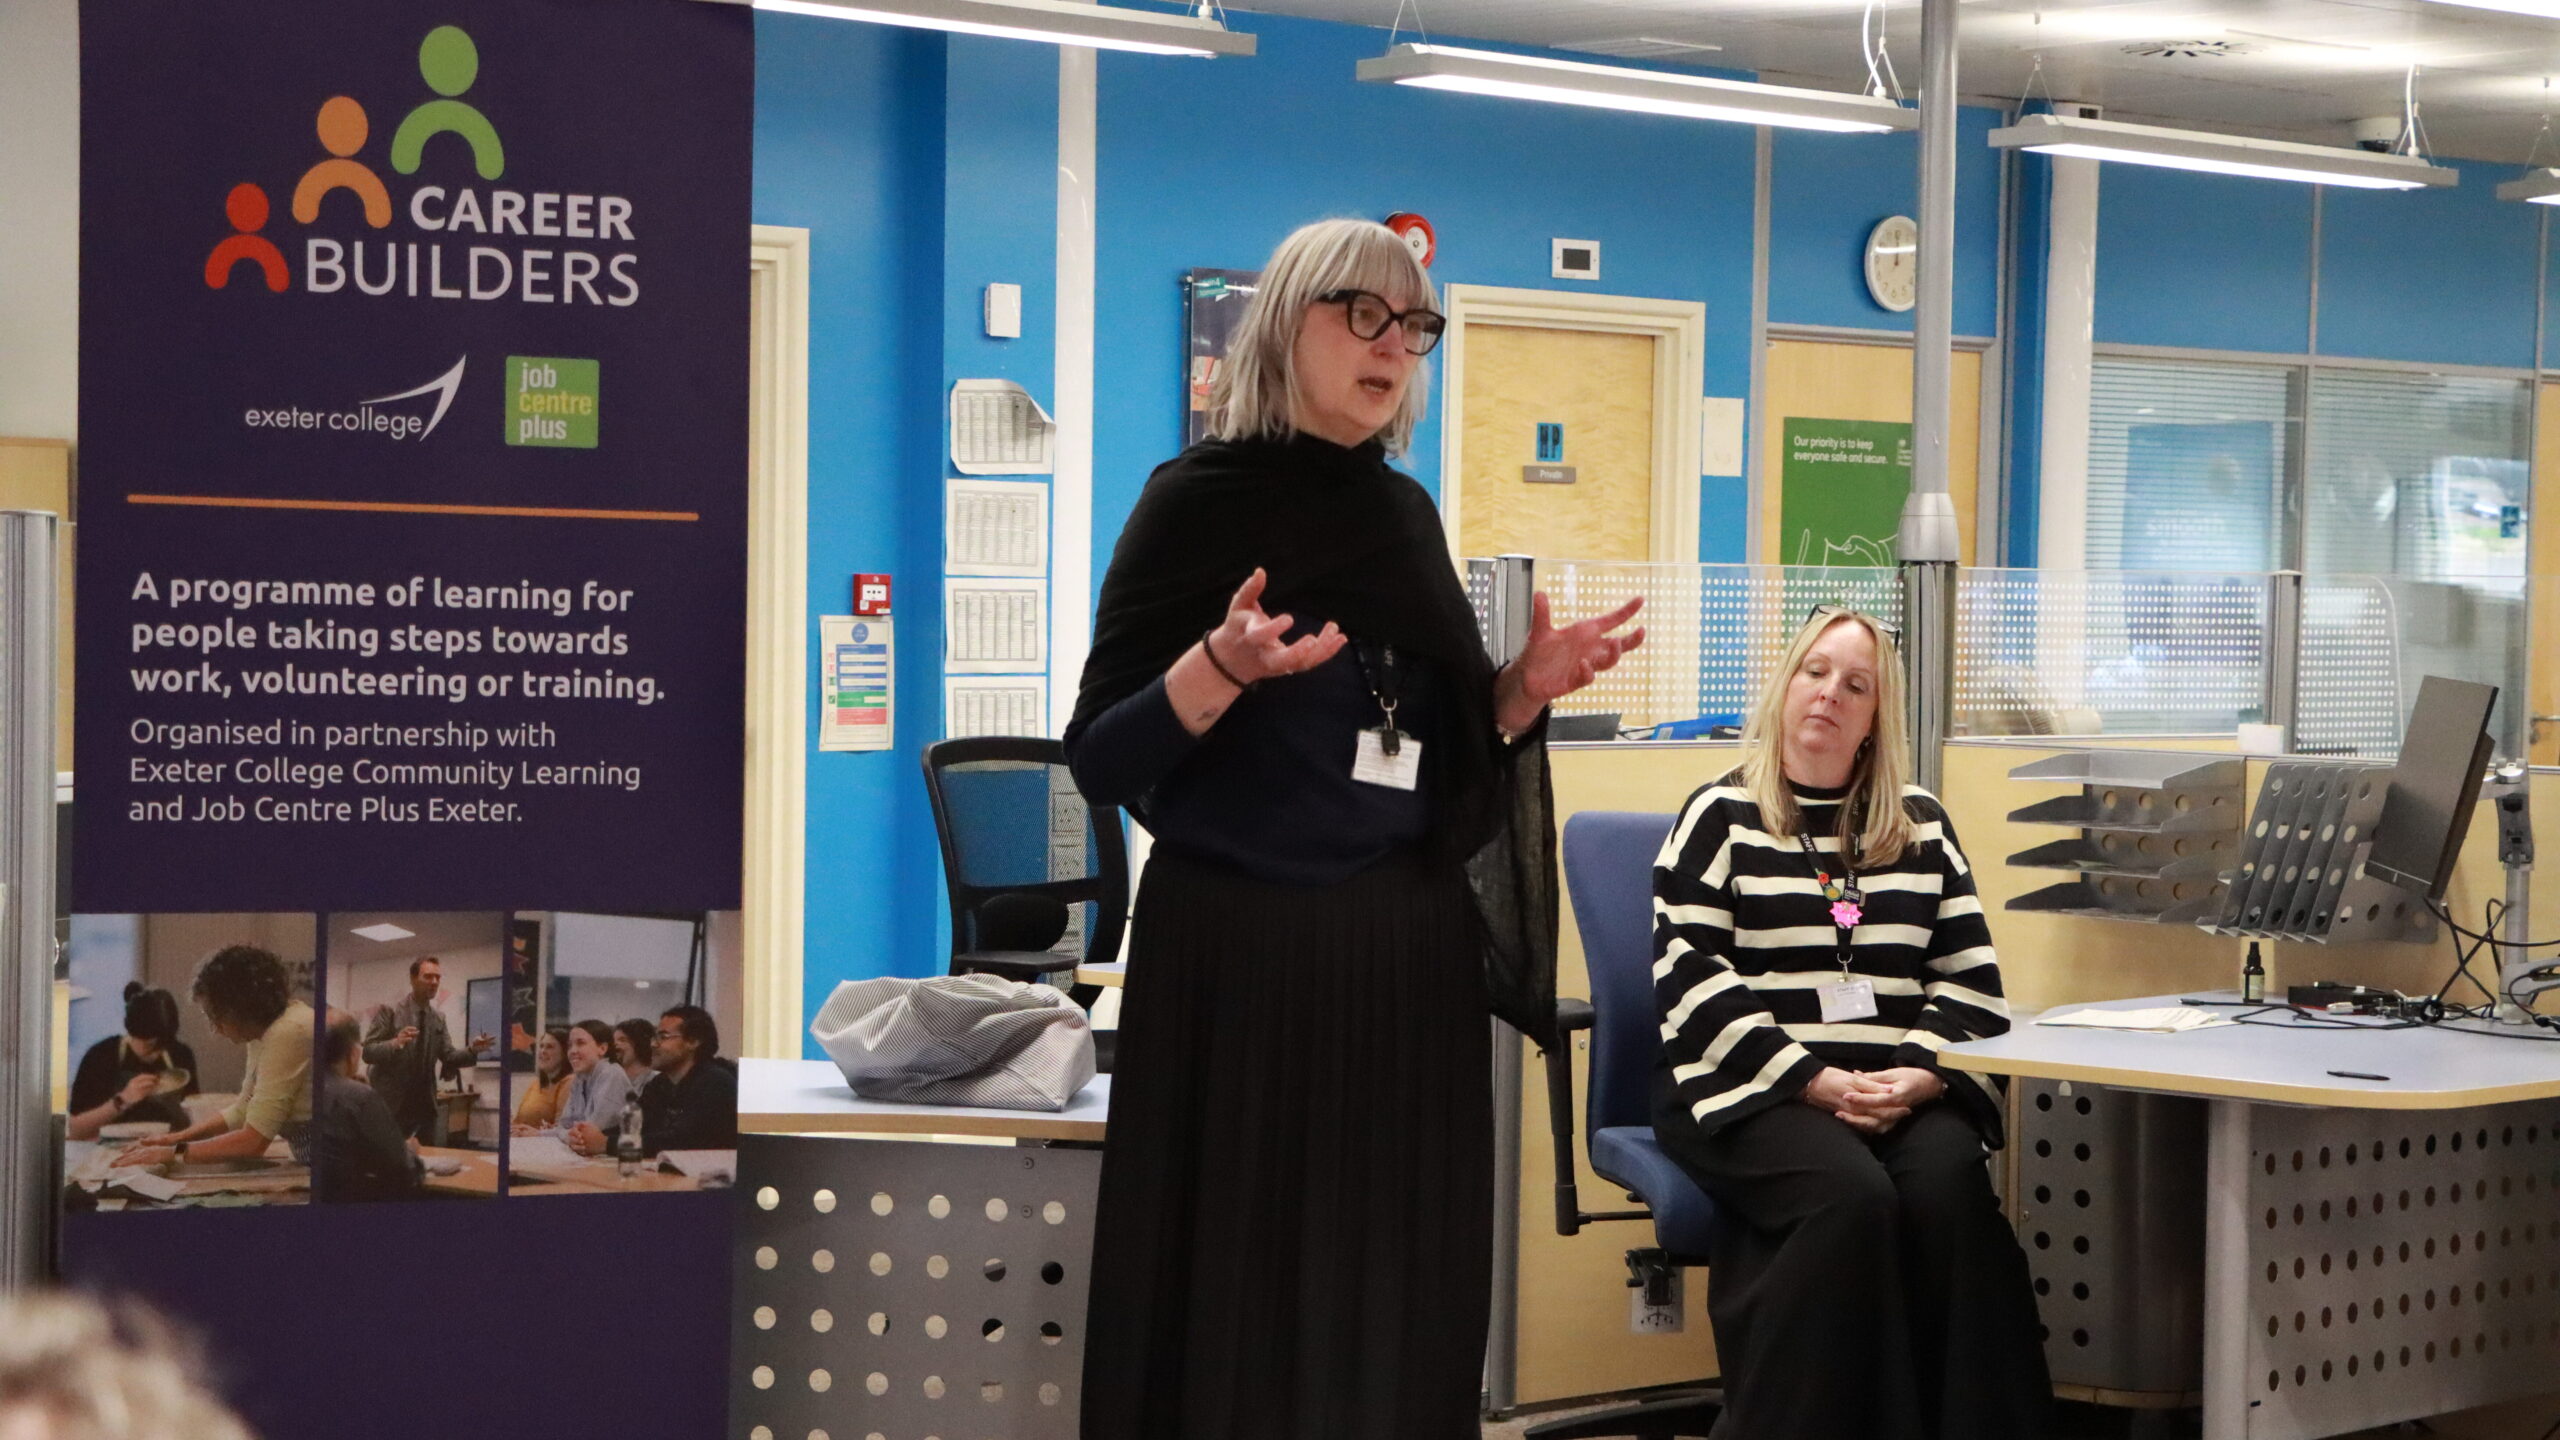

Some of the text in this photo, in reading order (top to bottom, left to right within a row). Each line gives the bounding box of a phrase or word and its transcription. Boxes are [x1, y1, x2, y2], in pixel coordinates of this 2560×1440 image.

[411, 186, 635, 240] CAREER
[307, 239, 639, 306] BUILDERS
[520, 362, 557, 390] job
[519, 389, 592, 416] centre
[245, 406, 422, 440] exeter college
[519, 415, 567, 444] plus
[1793, 435, 1874, 452] Our priority is to keep
[1793, 451, 1830, 464] everyone
[1830, 450, 1847, 462] safe
[1848, 452, 1863, 463] and
[132, 572, 633, 616] A programme of learning for
[133, 617, 628, 658] people taking steps towards
[131, 662, 664, 705] work, volunteering or training.
[131, 718, 555, 752] Organised in partnership with
[131, 757, 640, 791] Exeter College Community Learning
[129, 795, 522, 822] and Job Centre Plus Exeter.
[1800, 832, 1815, 853] STAFF
